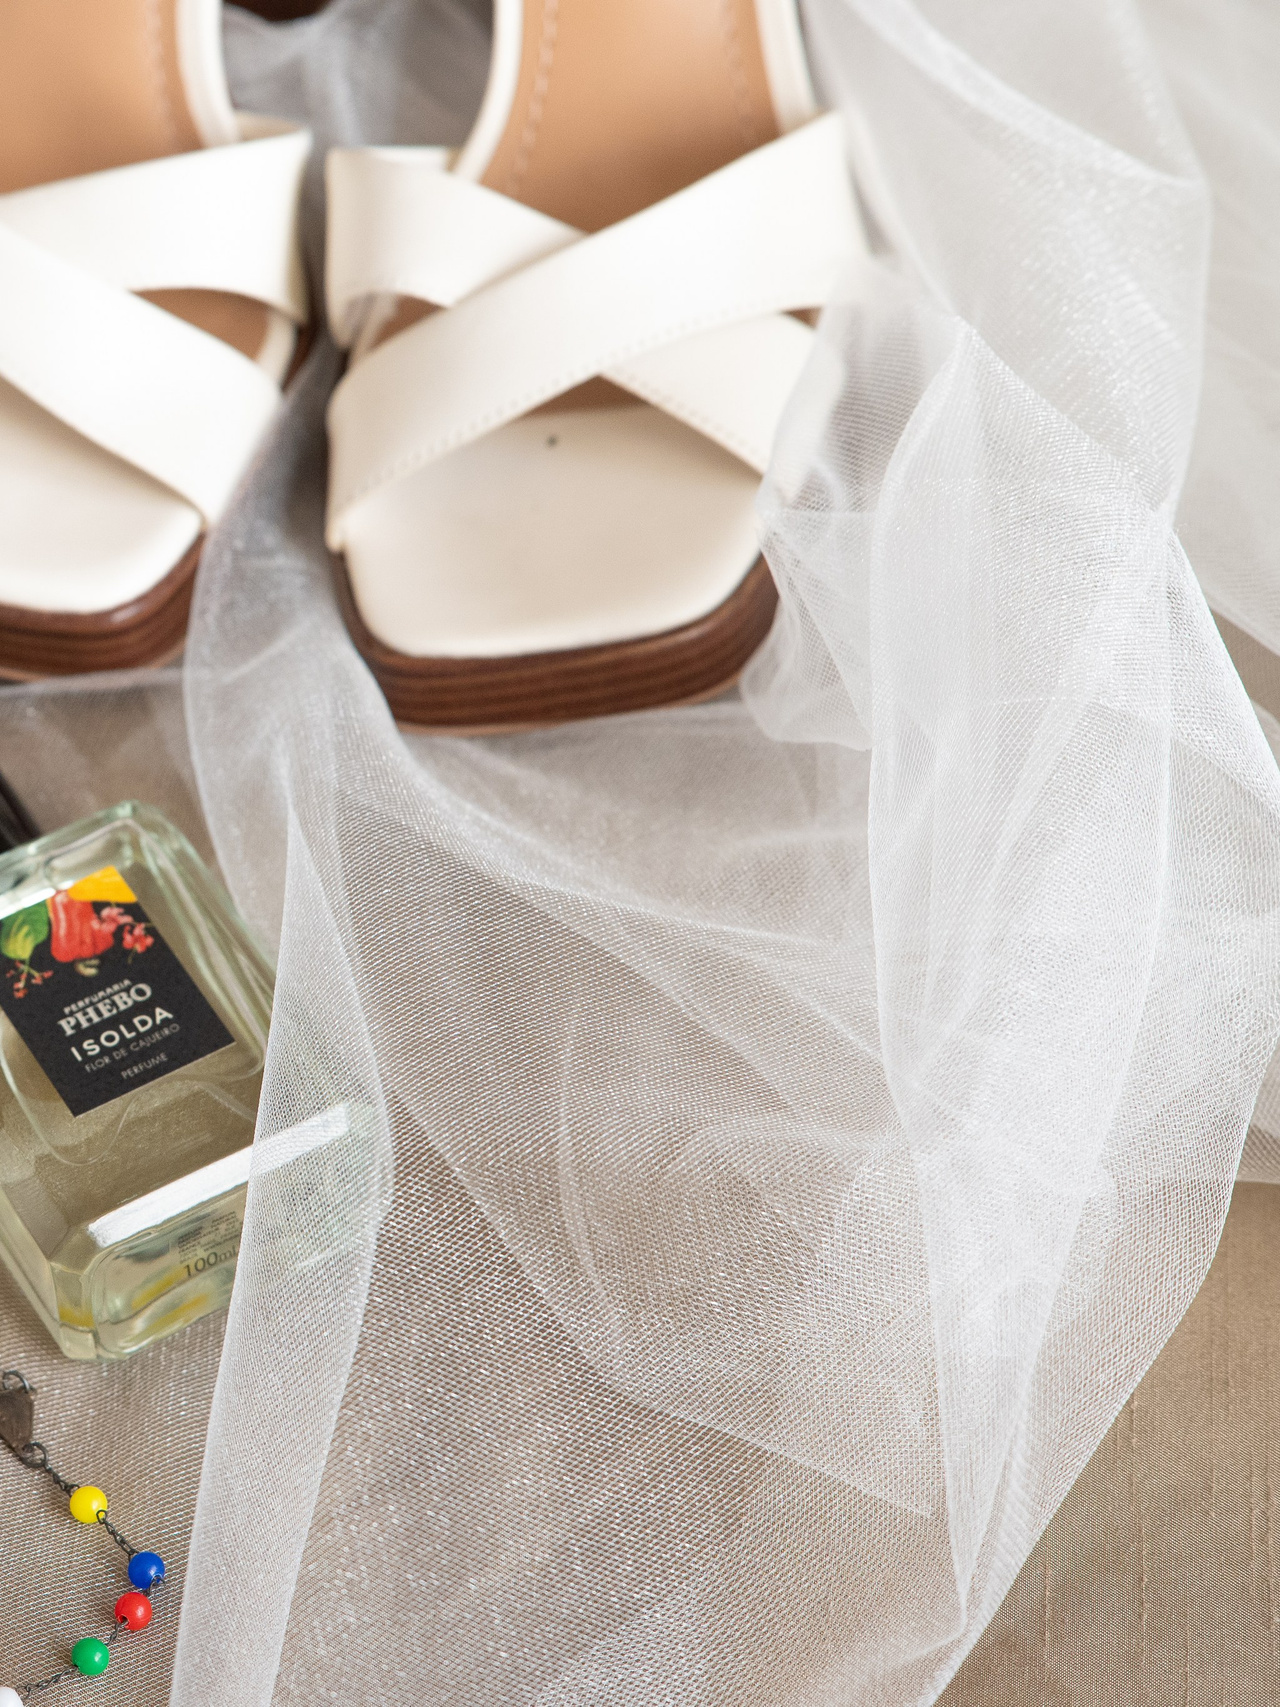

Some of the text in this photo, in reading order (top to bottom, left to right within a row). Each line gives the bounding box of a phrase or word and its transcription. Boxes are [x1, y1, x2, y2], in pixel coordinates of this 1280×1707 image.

[57, 983, 152, 1037] PHEBO
[63, 978, 132, 1015] PERFUMARIA
[71, 1007, 173, 1062] ISOLDA
[84, 1023, 180, 1073] FLOR DE CAJUEIRO
[121, 1052, 168, 1079] PERFUME
[183, 1245, 237, 1277] 100ml
